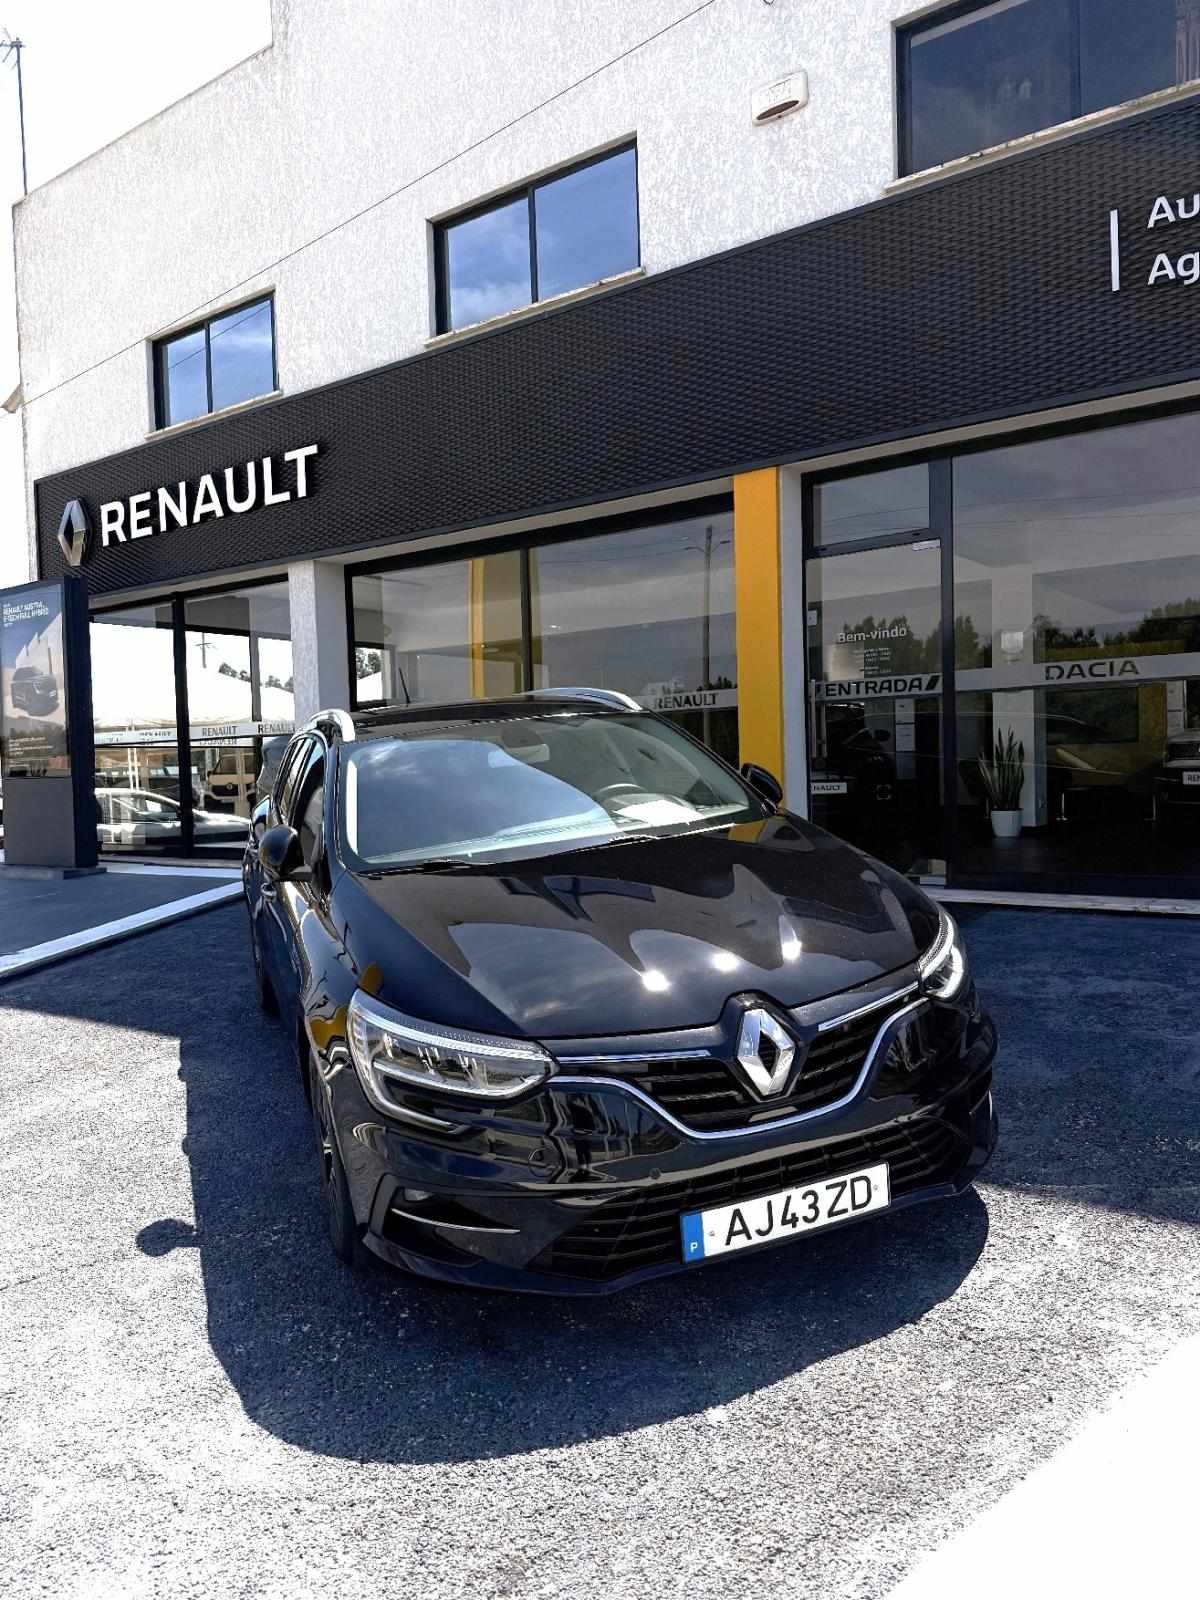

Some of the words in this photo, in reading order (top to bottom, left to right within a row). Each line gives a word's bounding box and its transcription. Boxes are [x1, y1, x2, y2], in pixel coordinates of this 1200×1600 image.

[1147, 193, 1200, 229] Au
[1147, 251, 1200, 286] Ag
[100, 444, 318, 547] RENAULT
[837, 625, 907, 643] Bem-vindo
[1045, 660, 1140, 681] DACIA
[825, 677, 922, 697] ENTRADA
[654, 692, 719, 709] RENAULT
[202, 725, 238, 737] RENAULT
[690, 1241, 698, 1253] P
